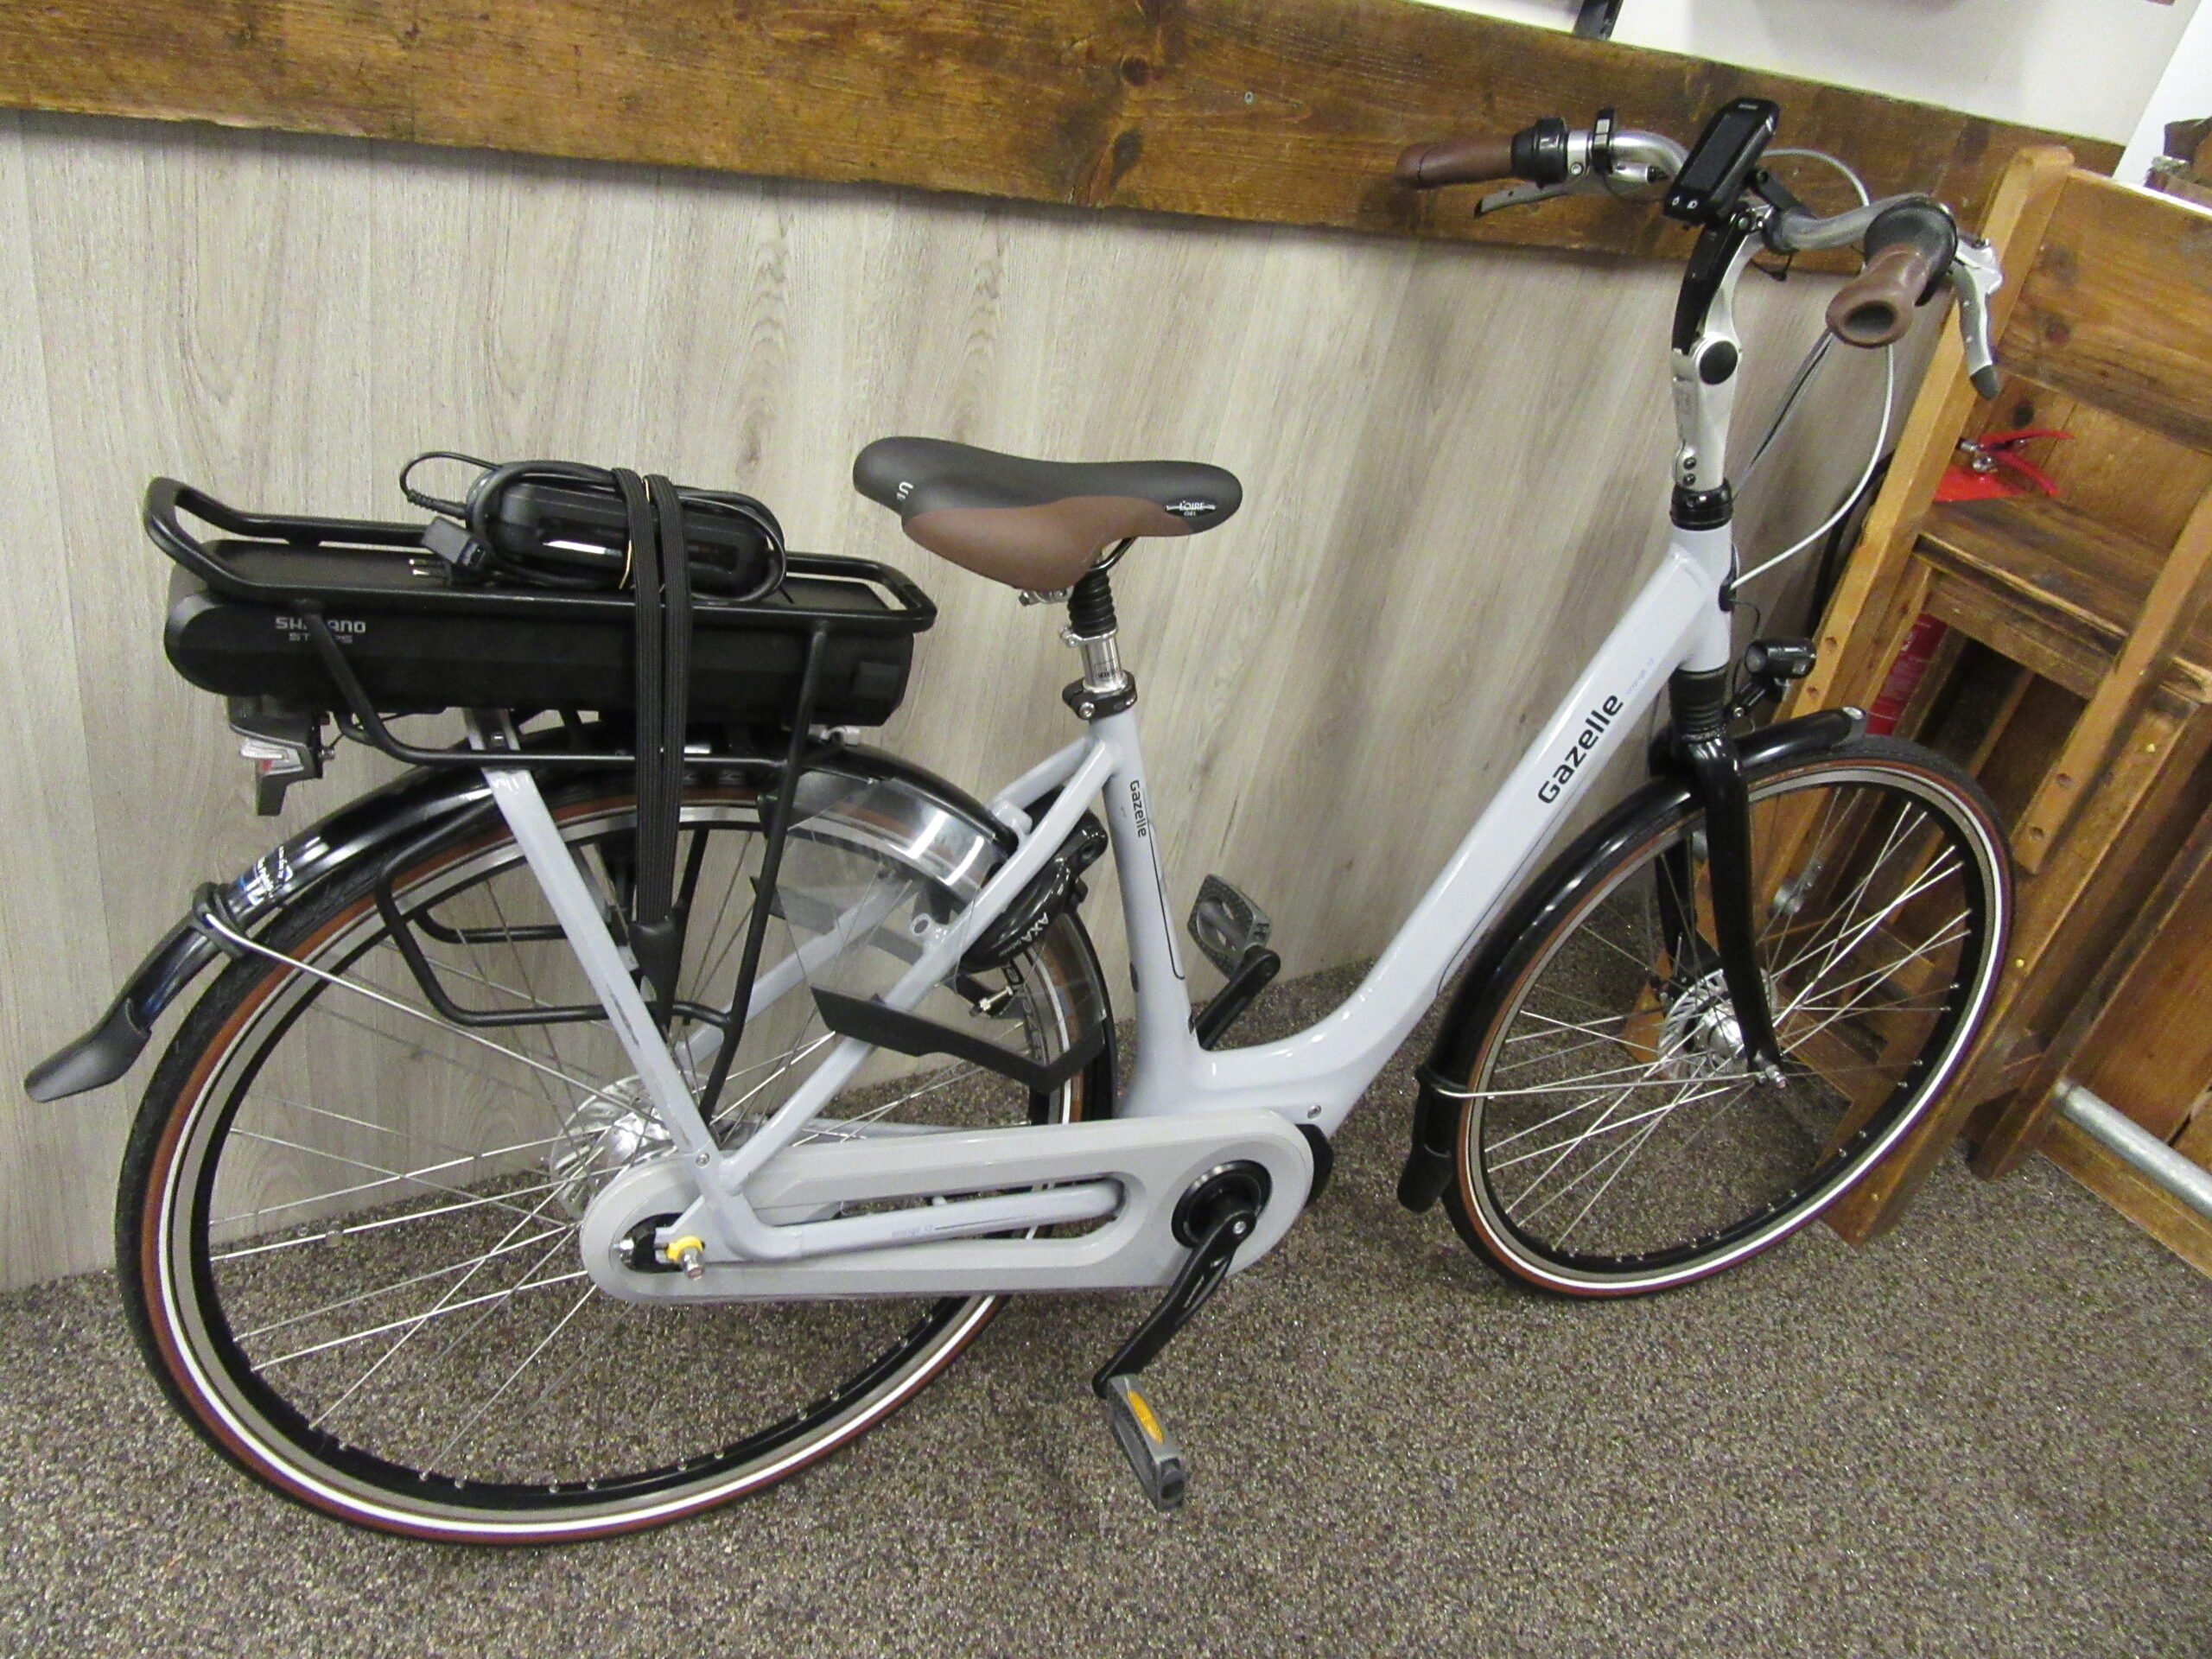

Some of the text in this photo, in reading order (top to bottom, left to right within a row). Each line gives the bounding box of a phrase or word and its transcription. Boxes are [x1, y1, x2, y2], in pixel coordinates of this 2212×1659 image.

[276, 616, 366, 633] SHANO
[289, 632, 353, 644] STPS
[1537, 695, 1624, 804] Gazelle
[1129, 779, 1147, 838] Gazelle
[1020, 912, 1049, 942] AXA
